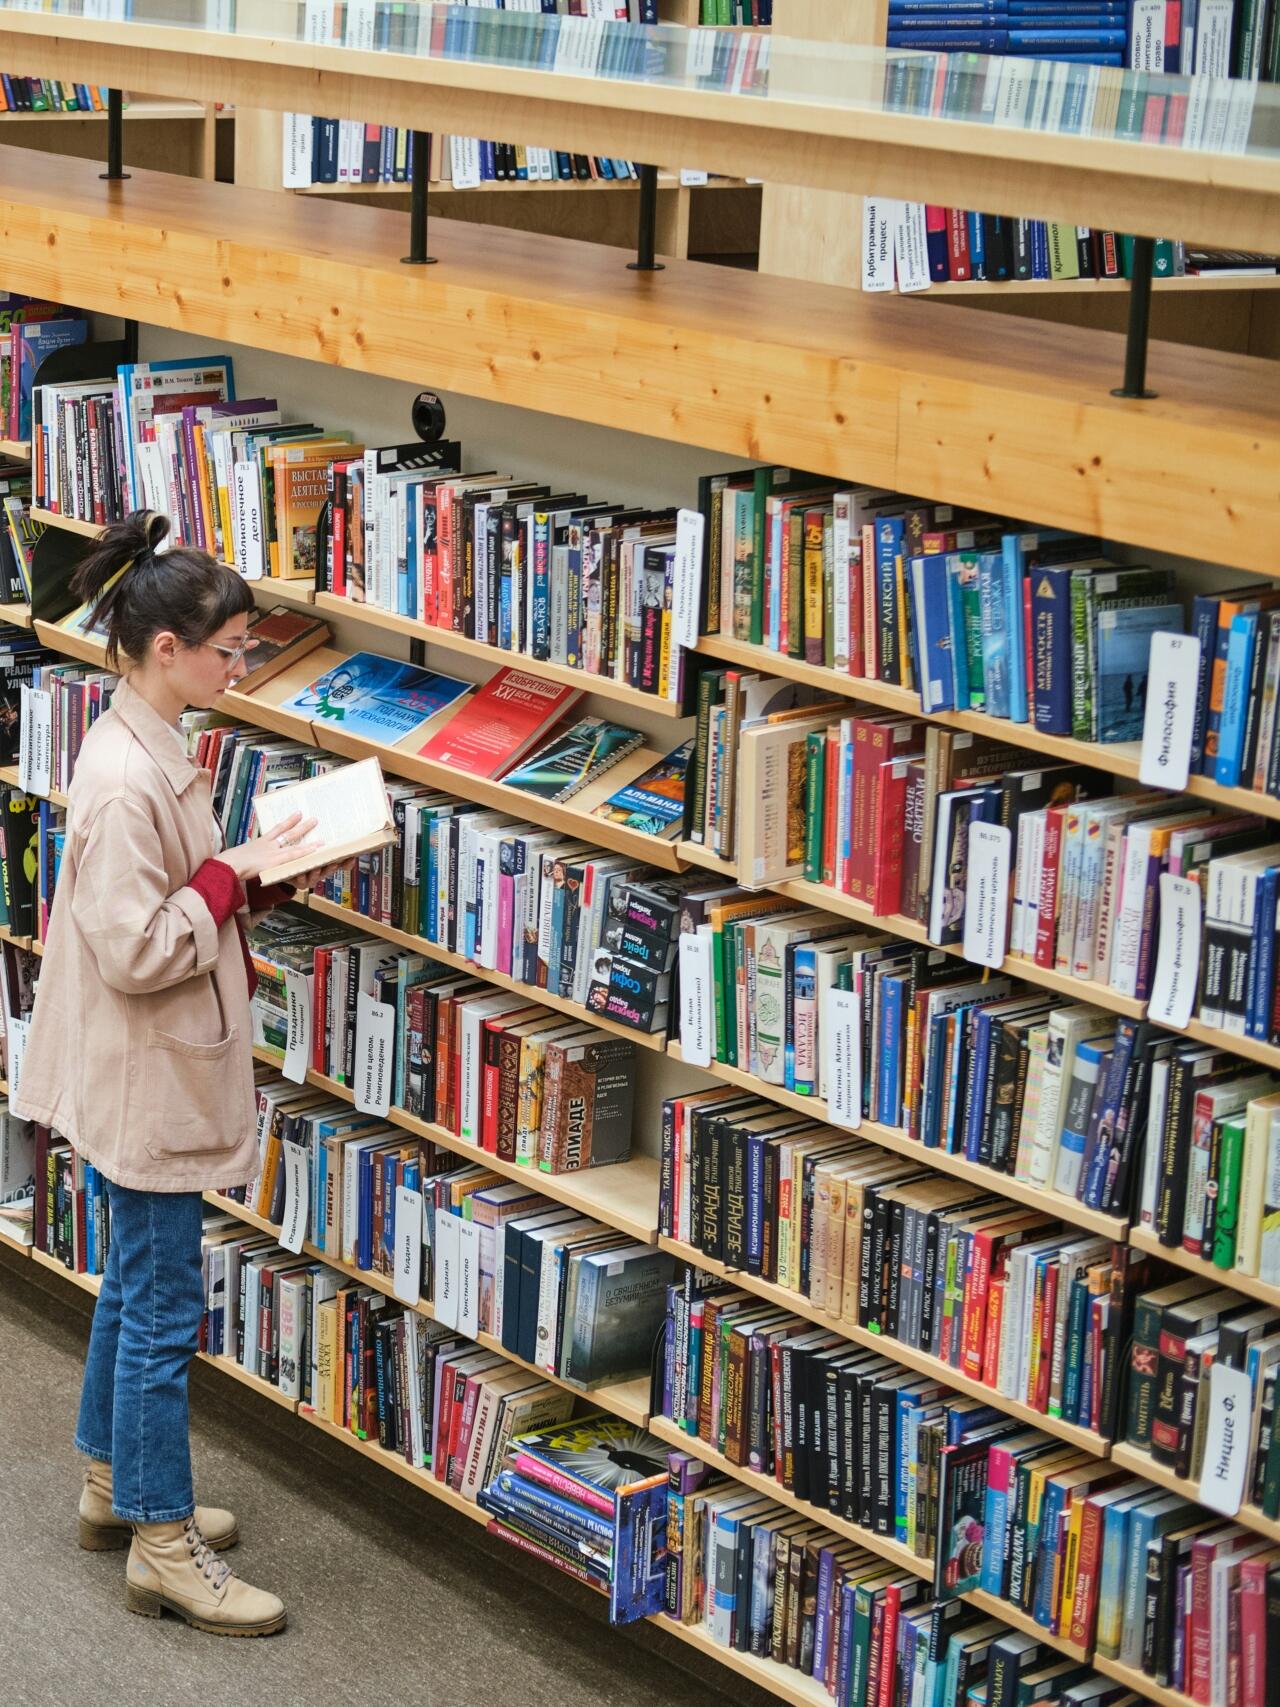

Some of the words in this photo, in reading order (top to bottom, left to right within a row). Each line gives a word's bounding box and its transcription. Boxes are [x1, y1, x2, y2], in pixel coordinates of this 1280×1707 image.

[867, 206, 878, 278] Арбитражный
[879, 220, 888, 261] процесс
[1052, 224, 1062, 272] Криминол
[90, 428, 98, 467] РЕАЛЬНЫЙ
[237, 476, 248, 574] Библиотечное
[250, 508, 260, 542] дело
[781, 534, 789, 565] ПАСХУ
[537, 597, 545, 644] РЯЗАНОВ
[982, 572, 992, 637] НЕБЕСНАЯ
[992, 579, 1002, 630] СТРАЖА
[1036, 612, 1046, 690] МУДРОСТЬ
[492, 684, 514, 702] XXI
[506, 672, 561, 696] ИЗОБРЕТЕНИЯ
[349, 708, 356, 716] И
[357, 710, 412, 732] ТЕХНОЛОГИЙ
[375, 704, 392, 714] ГОД
[392, 708, 422, 724] НАУКИ
[1158, 681, 1176, 766] Философия
[904, 786, 914, 832] ТИХИЕ
[912, 777, 925, 843] ОБИТЕЛИ
[2, 860, 10, 906] ФУТБОЛ
[990, 856, 999, 894] церковь
[976, 877, 986, 934] Католицизм.
[986, 897, 997, 958] Католическая
[622, 940, 650, 960] Грейс
[624, 933, 642, 944] Келли
[609, 972, 641, 994] Софи
[1164, 972, 1175, 1016] История
[1171, 907, 1184, 968] философии
[289, 992, 298, 1051] Праздники
[298, 1004, 306, 1044] (сценарии)
[608, 1002, 641, 1024] Брижит
[609, 996, 628, 1008] Бардо
[694, 977, 703, 1050] (Мусульманство)
[366, 1036, 374, 1064] целом.
[797, 1012, 808, 1066] ИСЛАМА
[834, 1030, 842, 1063] Магия.
[364, 1072, 373, 1104] Религия
[376, 1038, 385, 1105] Религиоведение
[565, 1098, 586, 1168] ЭЛИАДЕ
[662, 1124, 672, 1152] ЧИСЕЛ
[293, 1164, 301, 1198] религии
[663, 1157, 672, 1189] ТАЙНЫ
[752, 1145, 760, 1193] АПОКАЛИПСИС
[289, 1198, 299, 1244] Отдельные
[703, 1184, 720, 1243] ЗЕЛАНД
[727, 1192, 744, 1253] ЗЕЛАНД
[751, 1194, 760, 1255] РАСШИФРОВАННЫЙ
[403, 1235, 412, 1275] Буддизм
[861, 1236, 871, 1278] КАСТАНЕДА
[873, 1228, 884, 1278] КАСТАНЕДА
[890, 1233, 901, 1278] КАСТАНЕДА
[903, 1216, 914, 1260] КАСТАНЕДА
[914, 1220, 925, 1264] КАСТАНЕДА
[938, 1228, 948, 1266] КАСТАНЕДА
[442, 1259, 450, 1299] Иудаизм
[924, 1248, 934, 1288] КАСТАНЕДА
[956, 1238, 966, 1283] КАСТАНЕДА
[971, 1246, 981, 1300] СТРУКТУРНЫЙ
[979, 1256, 987, 1295] ГОРОСКОП
[462, 1258, 470, 1318] Христианство
[860, 1280, 869, 1308] КАРЛОС
[872, 1279, 882, 1305] КАРЛОС
[889, 1280, 898, 1310] КАРЛОС
[922, 1291, 932, 1319] КАРЛОС
[376, 1340, 384, 1370] ЗЕРНО
[1052, 1322, 1064, 1384] АСТРОЛОГИЯ
[377, 1372, 386, 1420] ГОРЧИЧНОЕ
[726, 1362, 735, 1426] МЕСЯЦЕСЛОВ
[1136, 1382, 1150, 1436] МОНТЕНЬ
[1224, 1394, 1236, 1412] Ф.
[1216, 1417, 1236, 1480] Ницше
[991, 1497, 1004, 1545] МИСТИКА
[990, 1546, 1000, 1574] ПУТЬ
[1010, 1526, 1024, 1599] НОСТРАДАМУС
